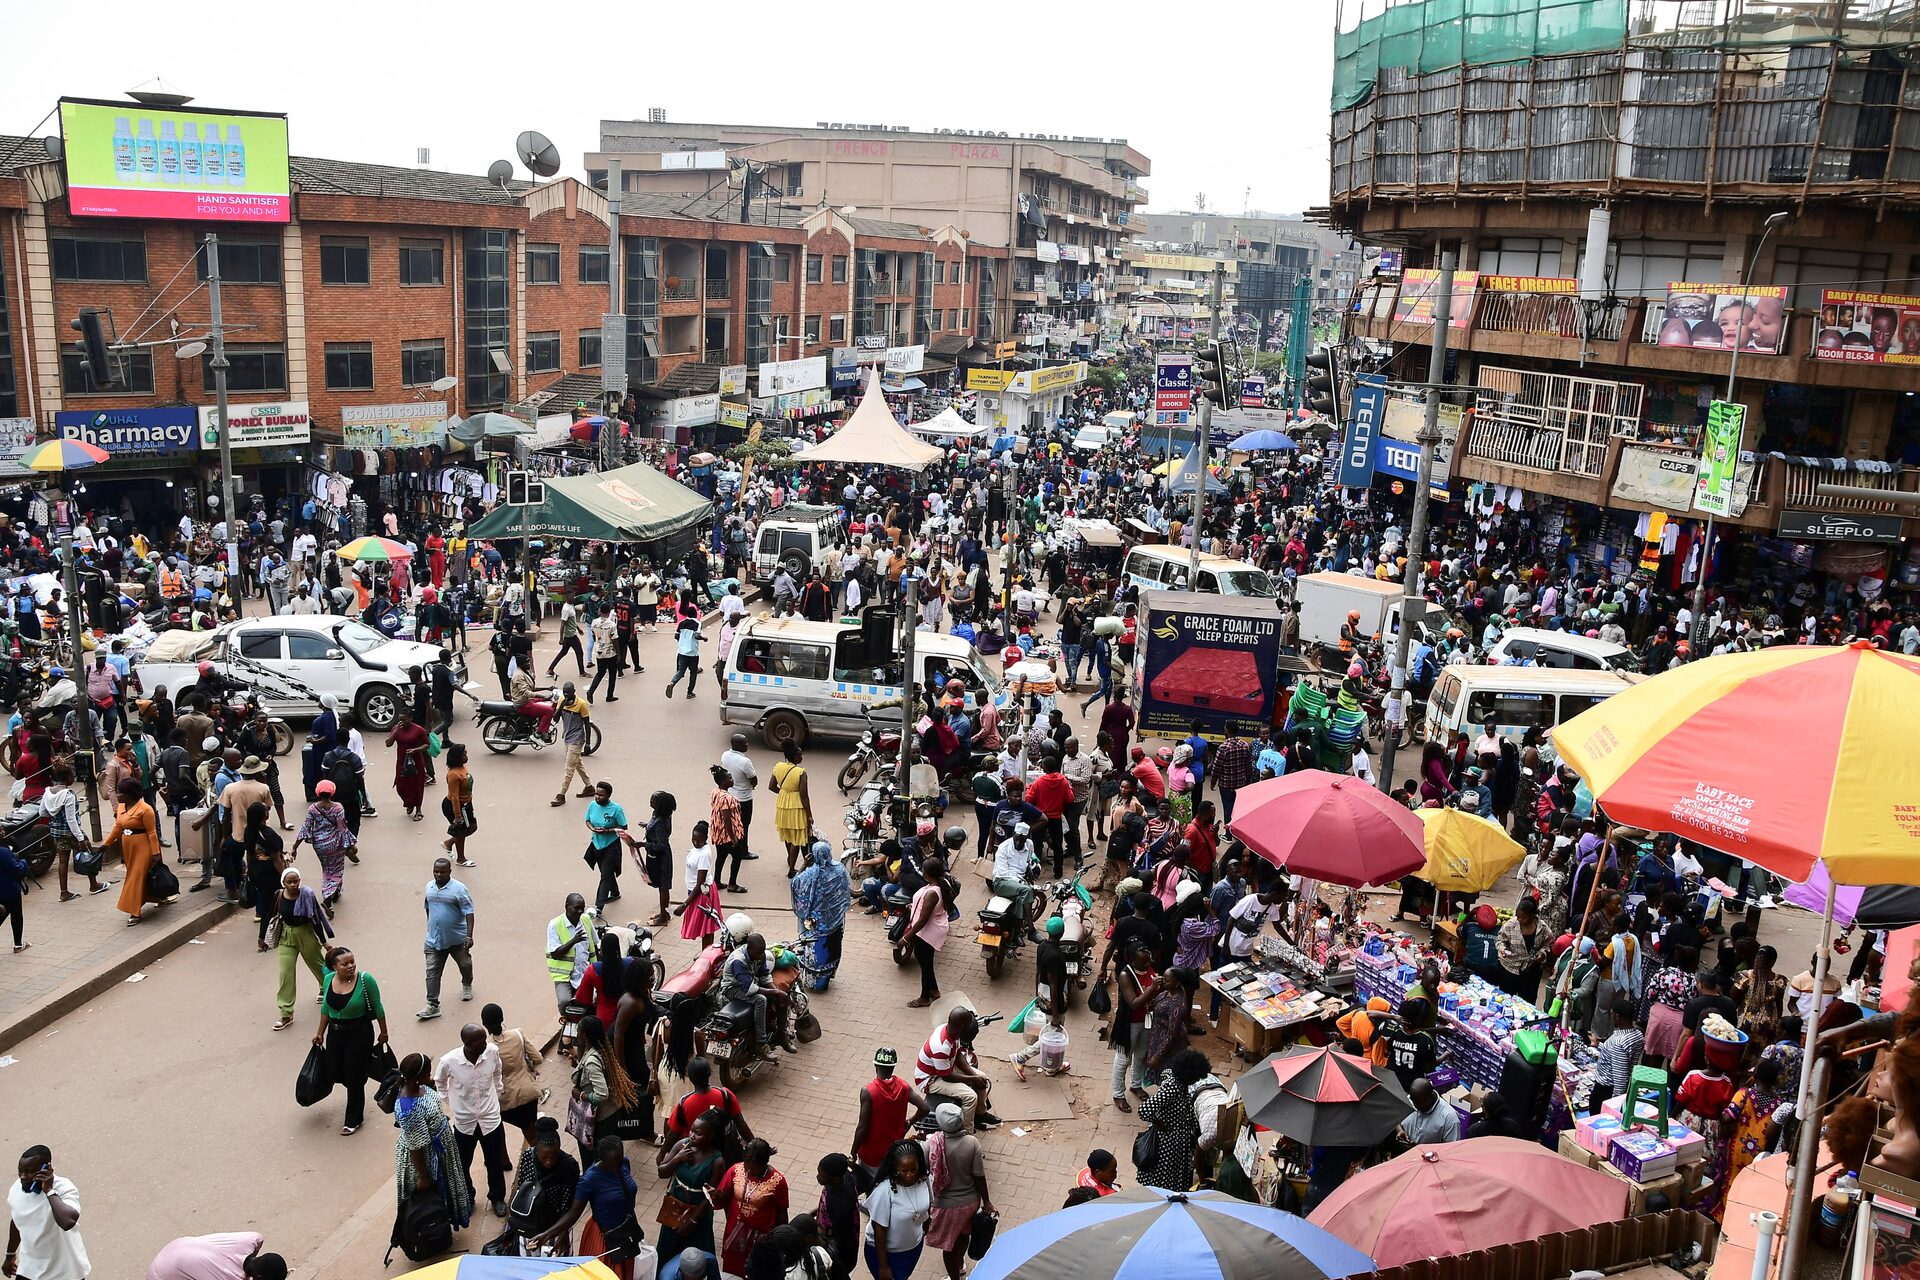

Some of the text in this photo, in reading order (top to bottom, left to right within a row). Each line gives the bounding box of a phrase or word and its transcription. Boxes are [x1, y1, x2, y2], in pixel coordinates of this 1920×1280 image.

[951, 144, 1000, 160] PLAZA
[198, 196, 278, 206] HAND SANITISER
[198, 206, 216, 214] FOR
[218, 206, 240, 214] YOU
[242, 207, 263, 215] AND
[1144, 256, 1180, 264] ENTER
[1454, 271, 1475, 282] GANIC
[1490, 277, 1518, 290] FACE
[1520, 278, 1574, 294] ORGANIC
[1671, 282, 1700, 293] BABY
[1827, 290, 1854, 300] BABY
[1856, 293, 1878, 302] FACE
[1818, 350, 1844, 358] ROOM
[836, 371, 856, 382] Pharmacy
[1158, 378, 1189, 388] Classic
[347, 404, 446, 420] GOMESI CORNER
[1440, 404, 1458, 412] Bright
[228, 415, 308, 428] FOREX BUREAU
[63, 424, 192, 446] Pharmacy
[1351, 394, 1375, 468] TECNO
[1386, 446, 1420, 472] TECN
[1661, 461, 1688, 472] CAPS
[1712, 495, 1724, 504] FREE
[1806, 526, 1874, 537] SLEEPLO
[1184, 616, 1274, 635] GRACE FOAM LTD
[1196, 631, 1258, 644] SLEEP EXPERTS
[1695, 782, 1754, 808] BABY FACE
[1696, 794, 1742, 814] ORGANIC
[1680, 796, 1751, 826] YOUNG LOOKING SKIN
[1684, 806, 1692, 814] All
[1694, 808, 1706, 820] Your
[1706, 816, 1718, 825] Skin
[1670, 810, 1748, 844] TEL: 0700 85 22 30
[1392, 1040, 1418, 1052] NICOLE
[877, 1054, 892, 1062] EAST
[1394, 1048, 1414, 1069] 19
[618, 1120, 640, 1128] QUALITY
